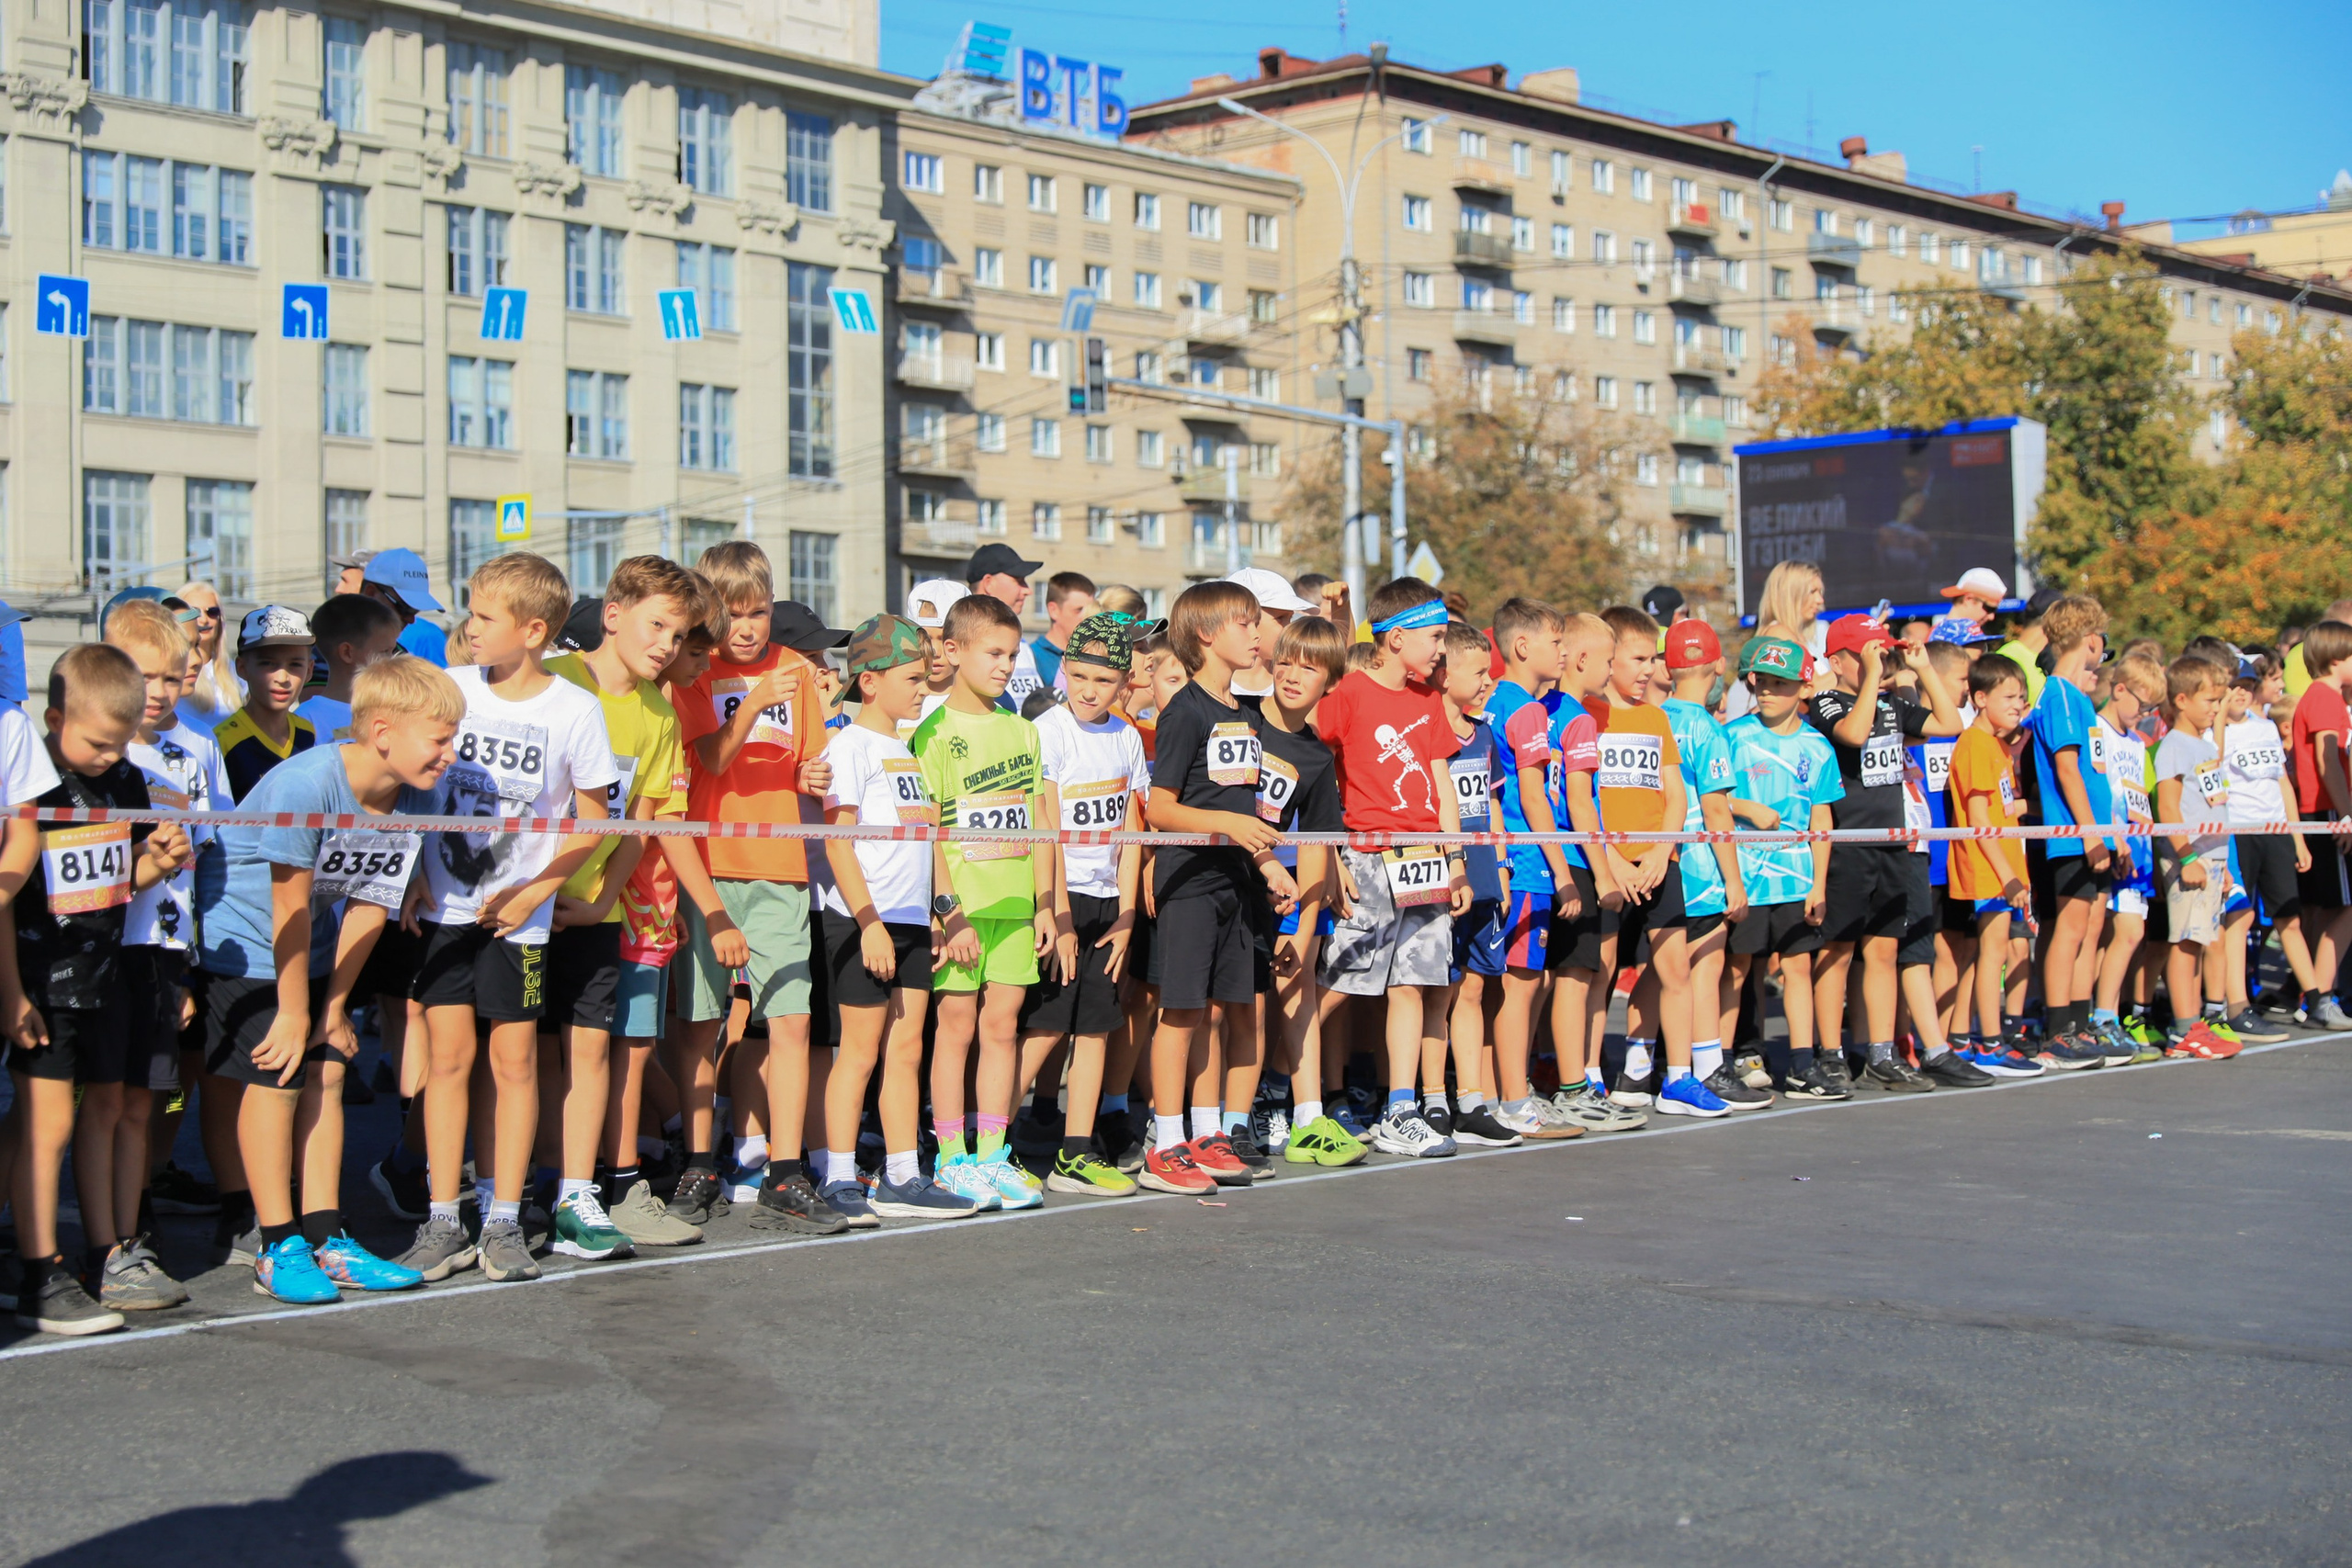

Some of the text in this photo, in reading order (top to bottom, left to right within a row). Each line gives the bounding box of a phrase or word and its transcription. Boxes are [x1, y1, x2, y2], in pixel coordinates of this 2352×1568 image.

[1017, 47, 1130, 136] ВТБ
[1747, 493, 1847, 536] ВЕЛИКИЙ
[565, 637, 581, 649] POLO
[724, 696, 788, 726] 848
[459, 732, 543, 774] 8358
[1604, 748, 1659, 771] 8020
[2237, 750, 2279, 767] 8355
[897, 775, 930, 802] 815
[963, 761, 1007, 790] СНЕЖНЫЕ
[968, 807, 1028, 829] 8282
[1073, 795, 1124, 825] 8189
[61, 844, 125, 884] 8141
[322, 851, 405, 877] 8358
[1398, 860, 1442, 886] 4277
